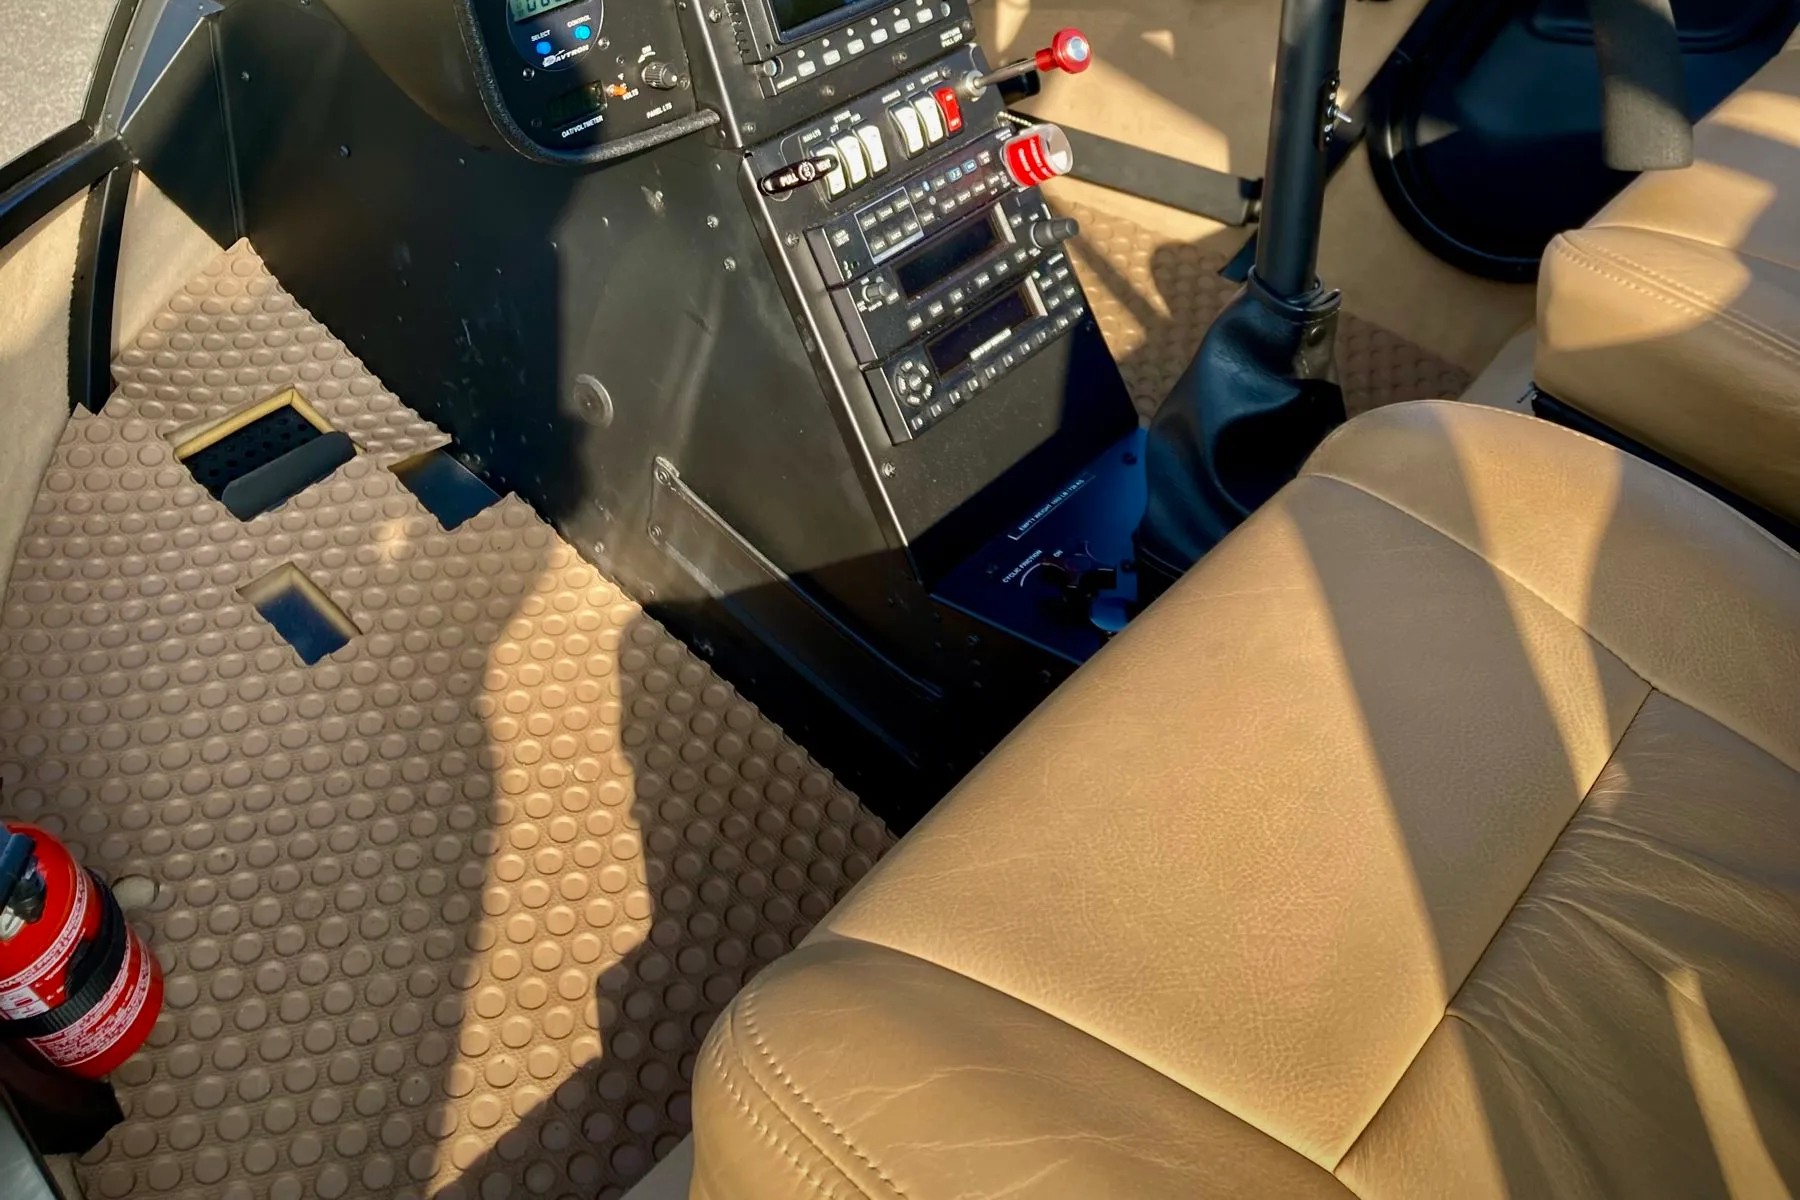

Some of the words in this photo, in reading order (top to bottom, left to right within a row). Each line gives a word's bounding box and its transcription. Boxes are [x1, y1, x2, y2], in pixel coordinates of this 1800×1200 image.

[567, 15, 591, 28] CONTROL
[531, 29, 551, 42] SELECT
[543, 45, 589, 67] DAVTRON
[646, 108, 663, 119] PANEL
[663, 102, 673, 111] LTS
[561, 115, 604, 138] OAT/VOLTMETER
[779, 172, 800, 188] PULL
[1018, 517, 1034, 531] EMPTY
[1034, 504, 1051, 518] WEIGHT
[1002, 566, 1020, 584] CYCLIC
[1020, 549, 1043, 569] FRICTION
